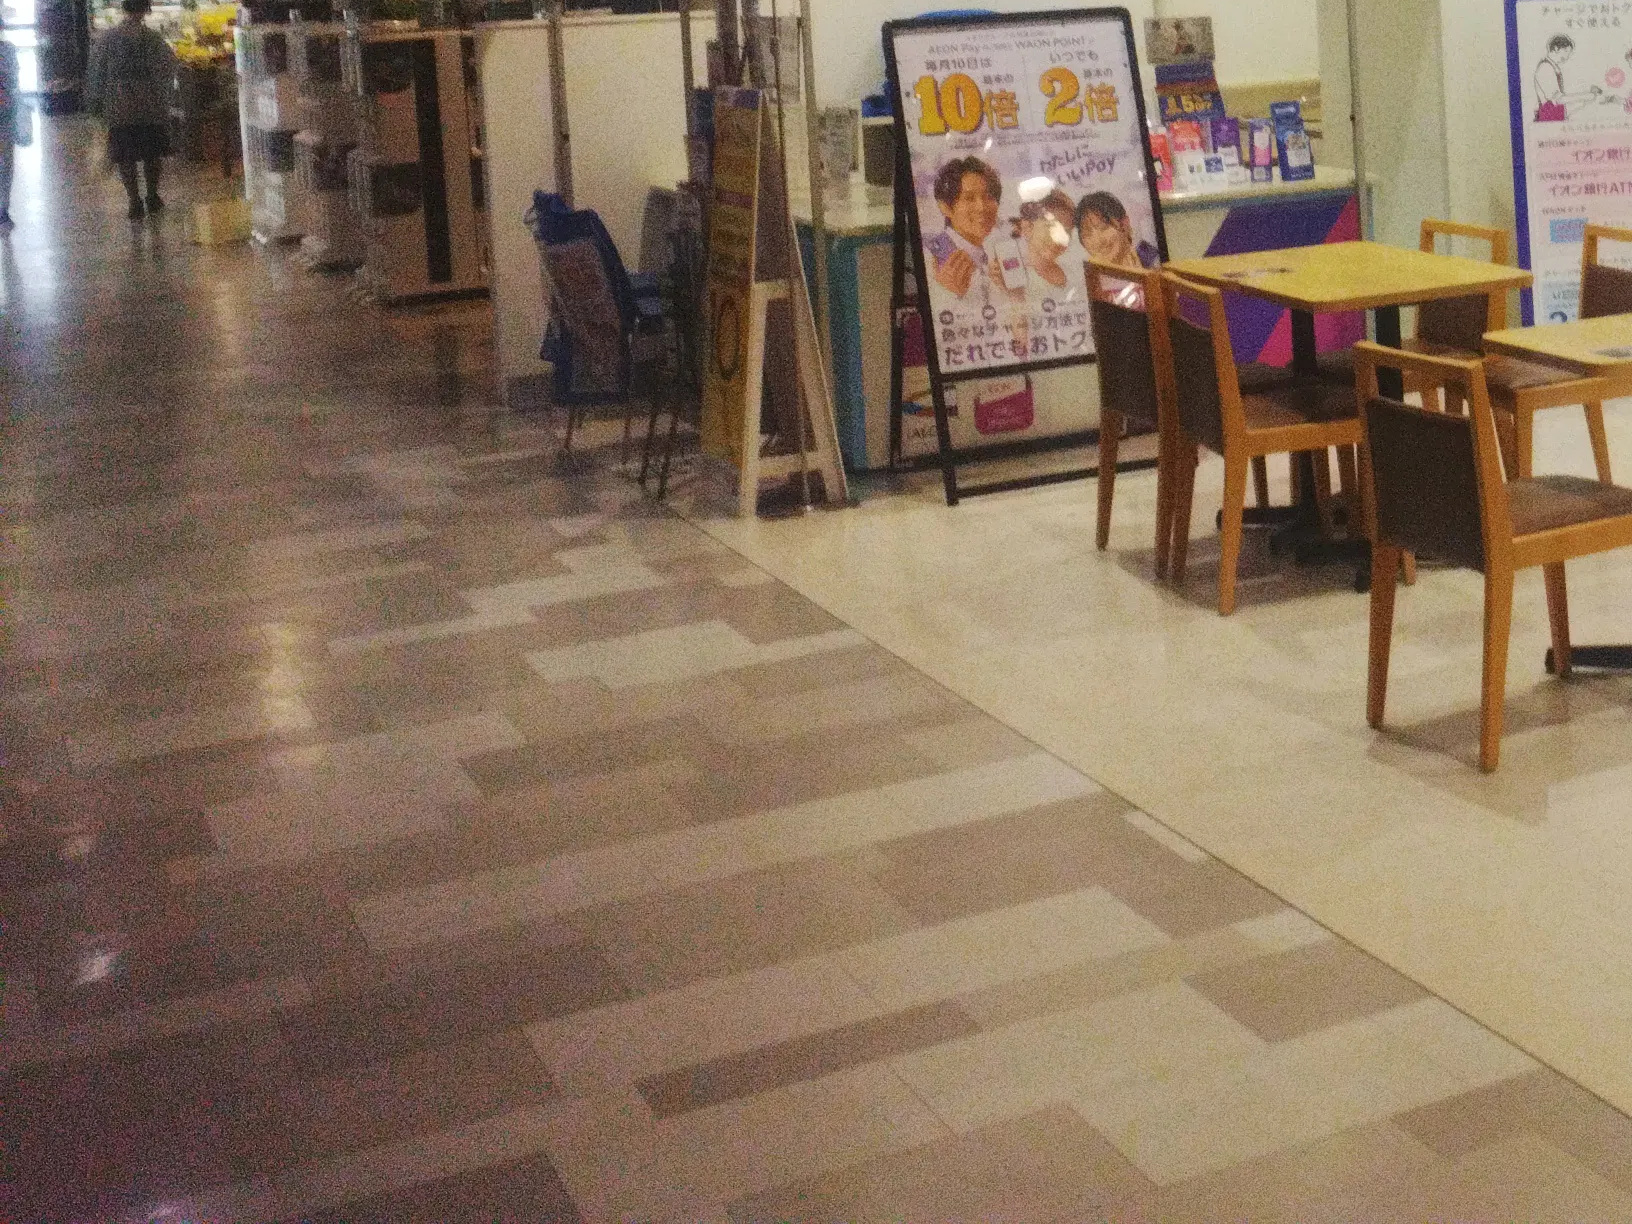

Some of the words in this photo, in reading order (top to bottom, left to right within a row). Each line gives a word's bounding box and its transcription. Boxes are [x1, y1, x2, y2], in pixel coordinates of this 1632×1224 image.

[1049, 50, 1099, 62] いつでも
[925, 57, 992, 72] 毎月10日は
[1571, 146, 1631, 162] イオン銀行
[944, 329, 1087, 366] だれでもおトク
